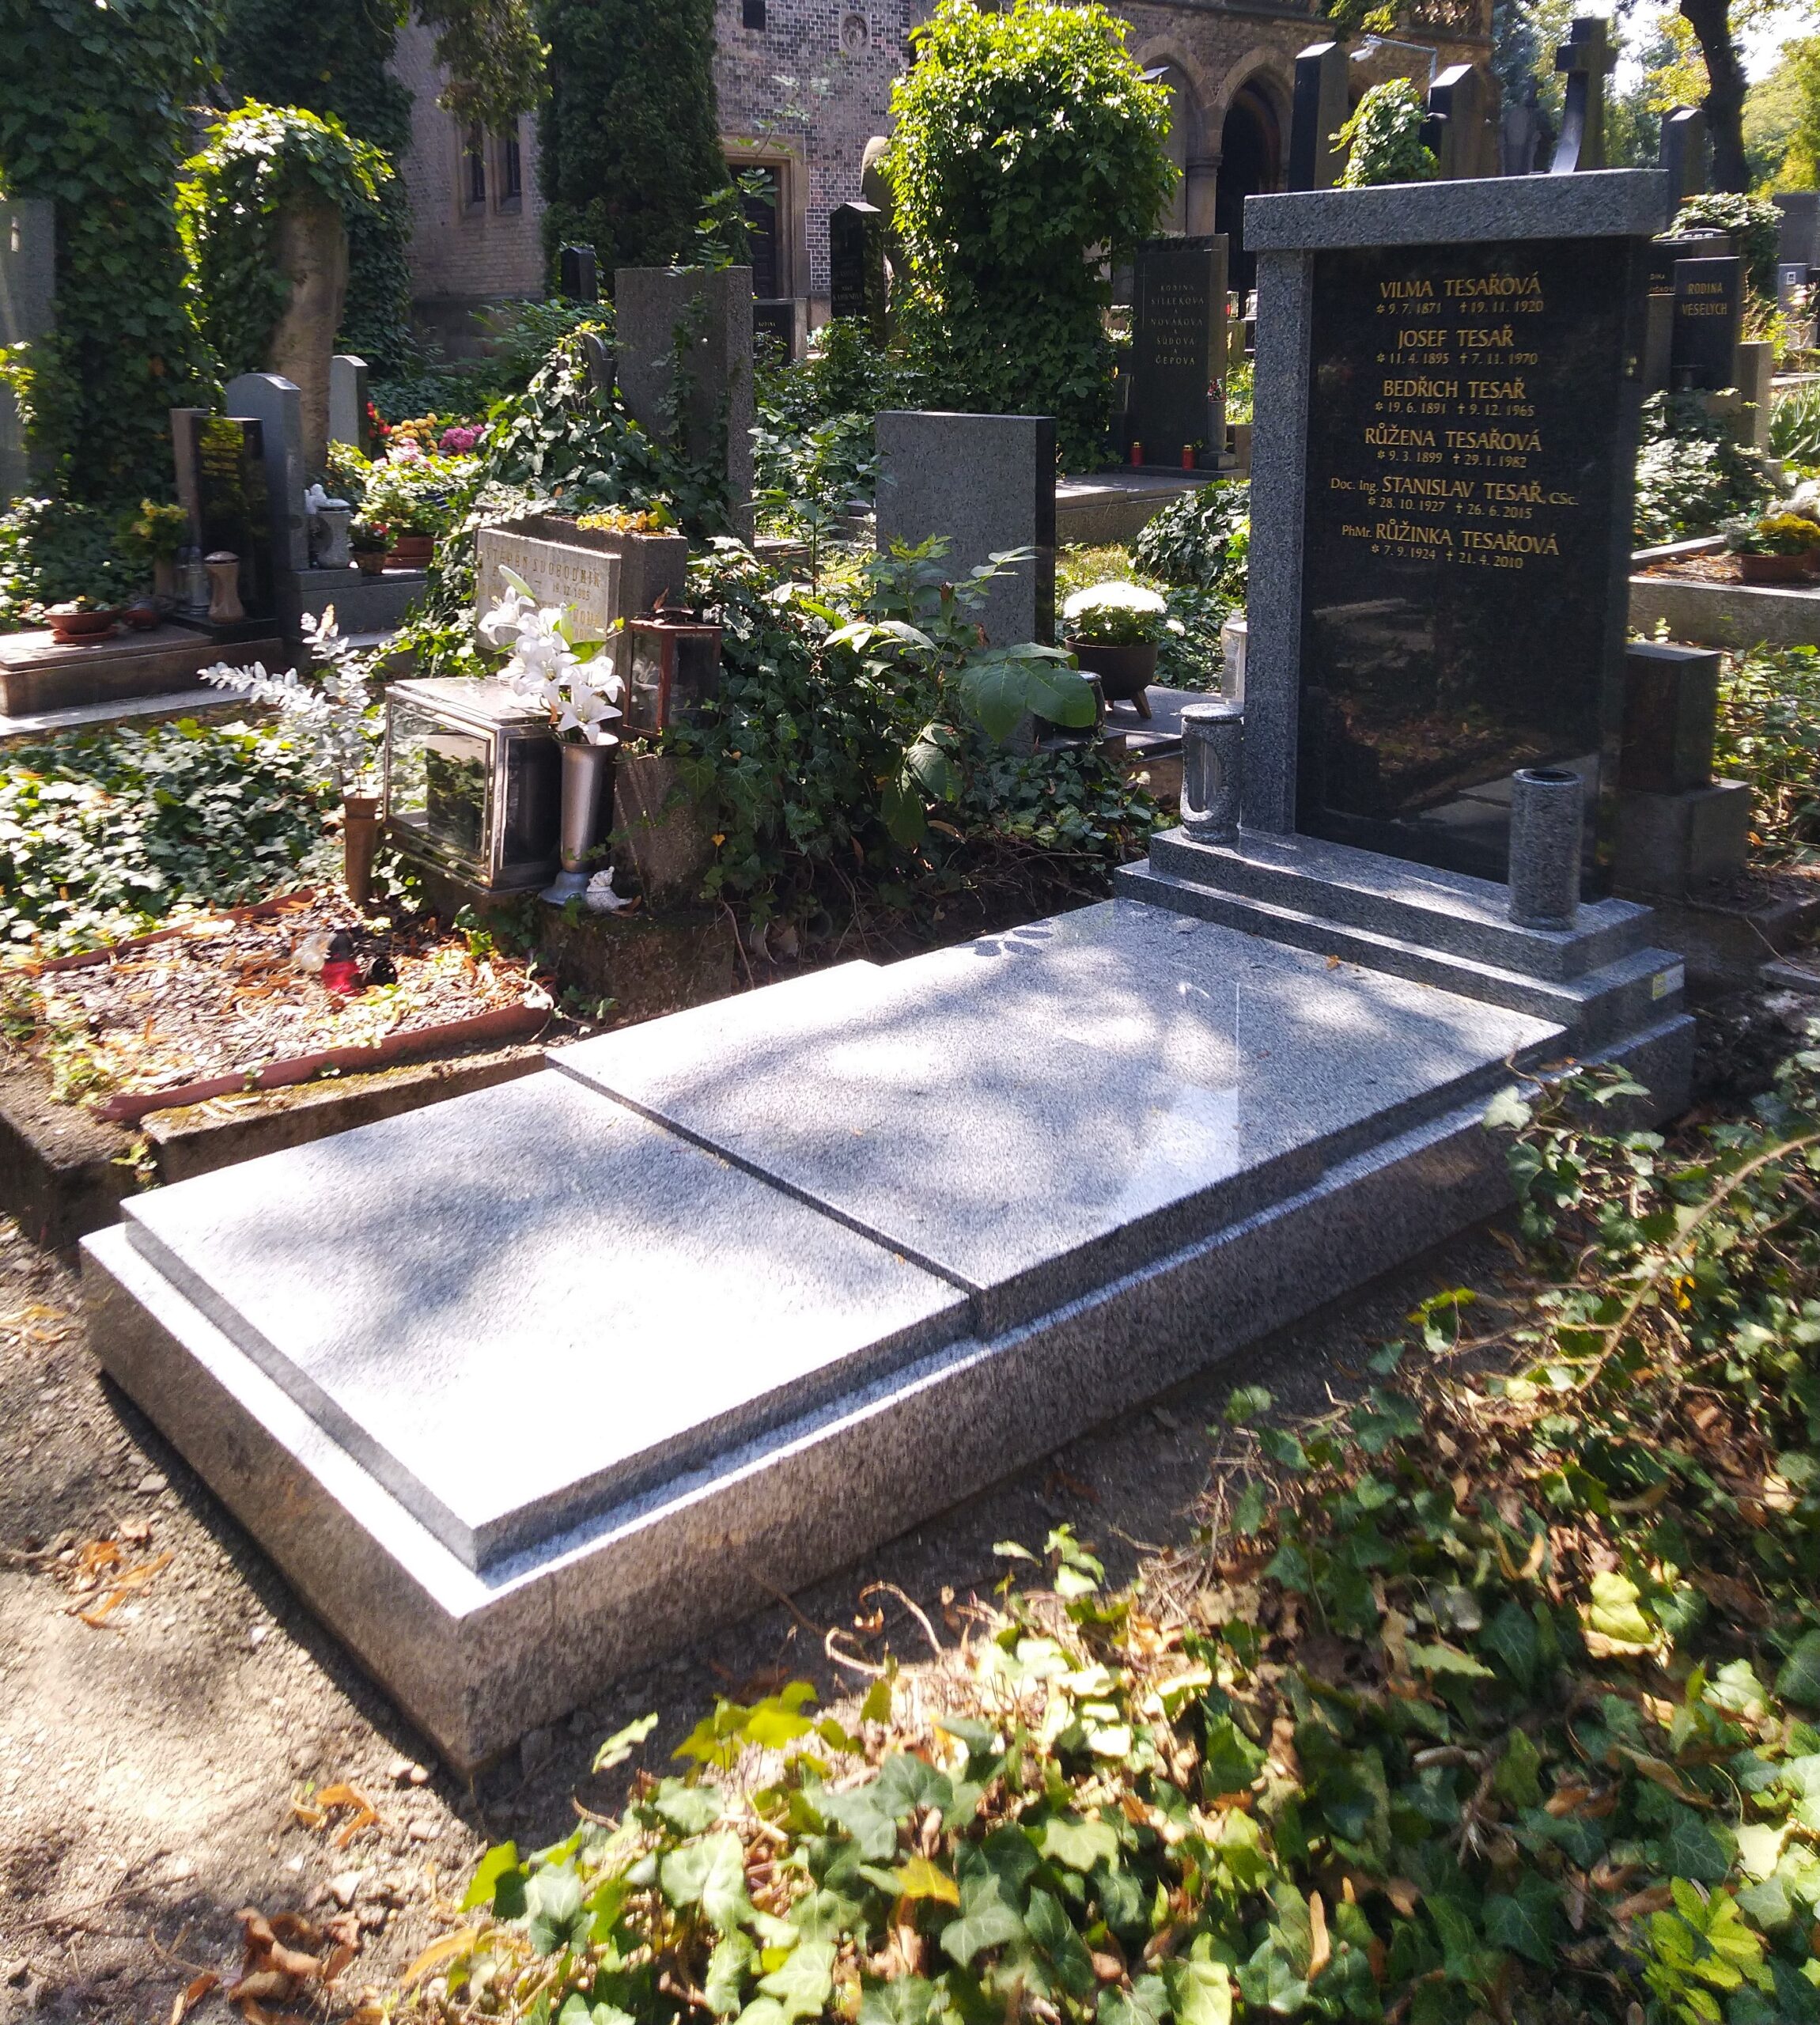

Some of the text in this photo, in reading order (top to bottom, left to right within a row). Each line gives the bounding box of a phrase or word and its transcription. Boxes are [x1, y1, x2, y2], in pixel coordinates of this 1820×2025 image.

[1380, 271, 1542, 298] VILMA TESAŘOVÁ
[1686, 282, 1724, 294] RODINA
[1417, 302, 1442, 314] 1871
[1515, 300, 1544, 312] 1920
[1398, 324, 1515, 350] JOSEF TESAŘ
[1423, 353, 1450, 365] 1895
[1509, 353, 1538, 365] 1970
[1383, 376, 1526, 399] BEDŘICH TESAŘ
[1421, 403, 1446, 414] 1891
[1506, 404, 1534, 417] 1965
[1365, 422, 1542, 452] RŮŽENA TESAŘOVÁ
[1417, 452, 1443, 464] 1899
[1499, 455, 1527, 468] 1982
[1330, 478, 1356, 490] Doc.
[1359, 479, 1379, 494] Ing.
[1382, 476, 1475, 498] STANISLAV
[1549, 492, 1580, 505] CSc.
[1420, 500, 1446, 513] 1927
[1503, 506, 1533, 519] 2015
[1375, 518, 1453, 546] RŮŽINKA
[1462, 529, 1560, 555] TESAŘOVÁ
[1410, 547, 1436, 560] 1924
[1493, 555, 1524, 569] 2010
